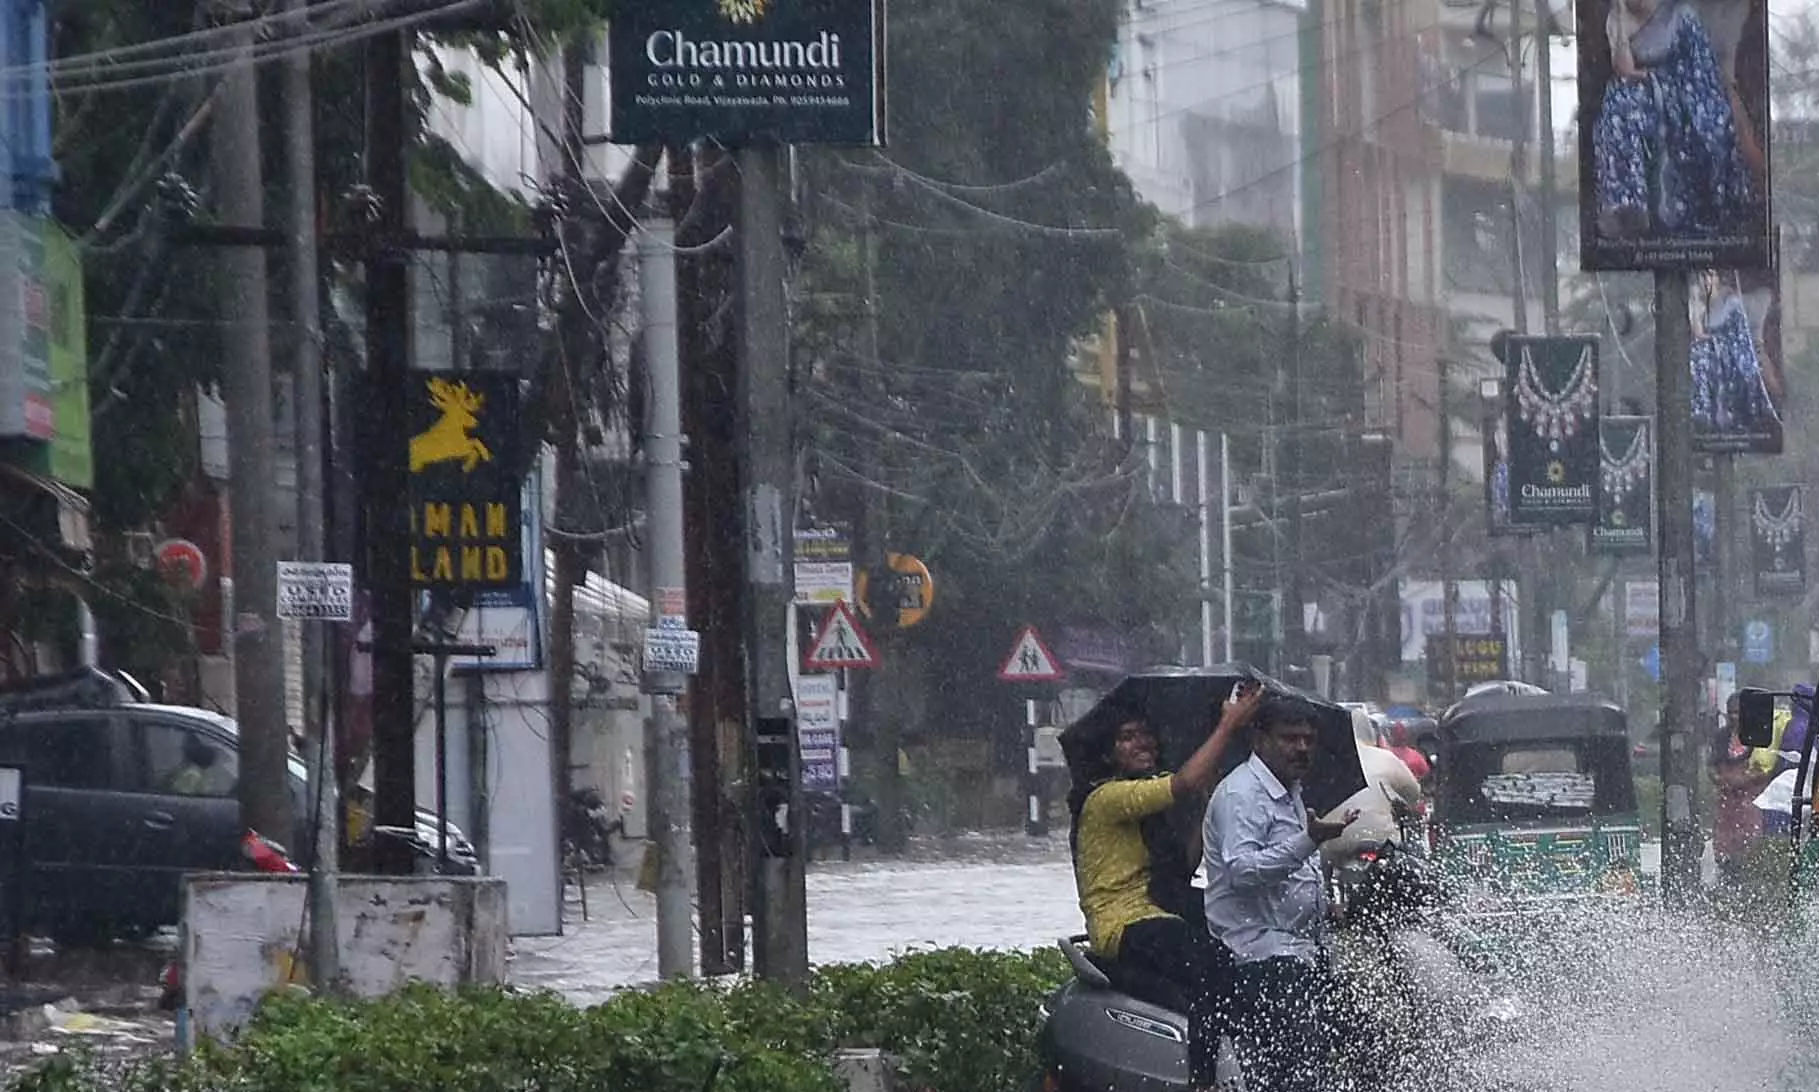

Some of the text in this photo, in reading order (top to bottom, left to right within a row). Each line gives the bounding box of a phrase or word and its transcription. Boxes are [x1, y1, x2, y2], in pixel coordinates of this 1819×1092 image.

[646, 30, 840, 68] Chamundi
[647, 73, 846, 88] GOLD & DIAMONDS
[1521, 484, 1591, 498] Chamundi
